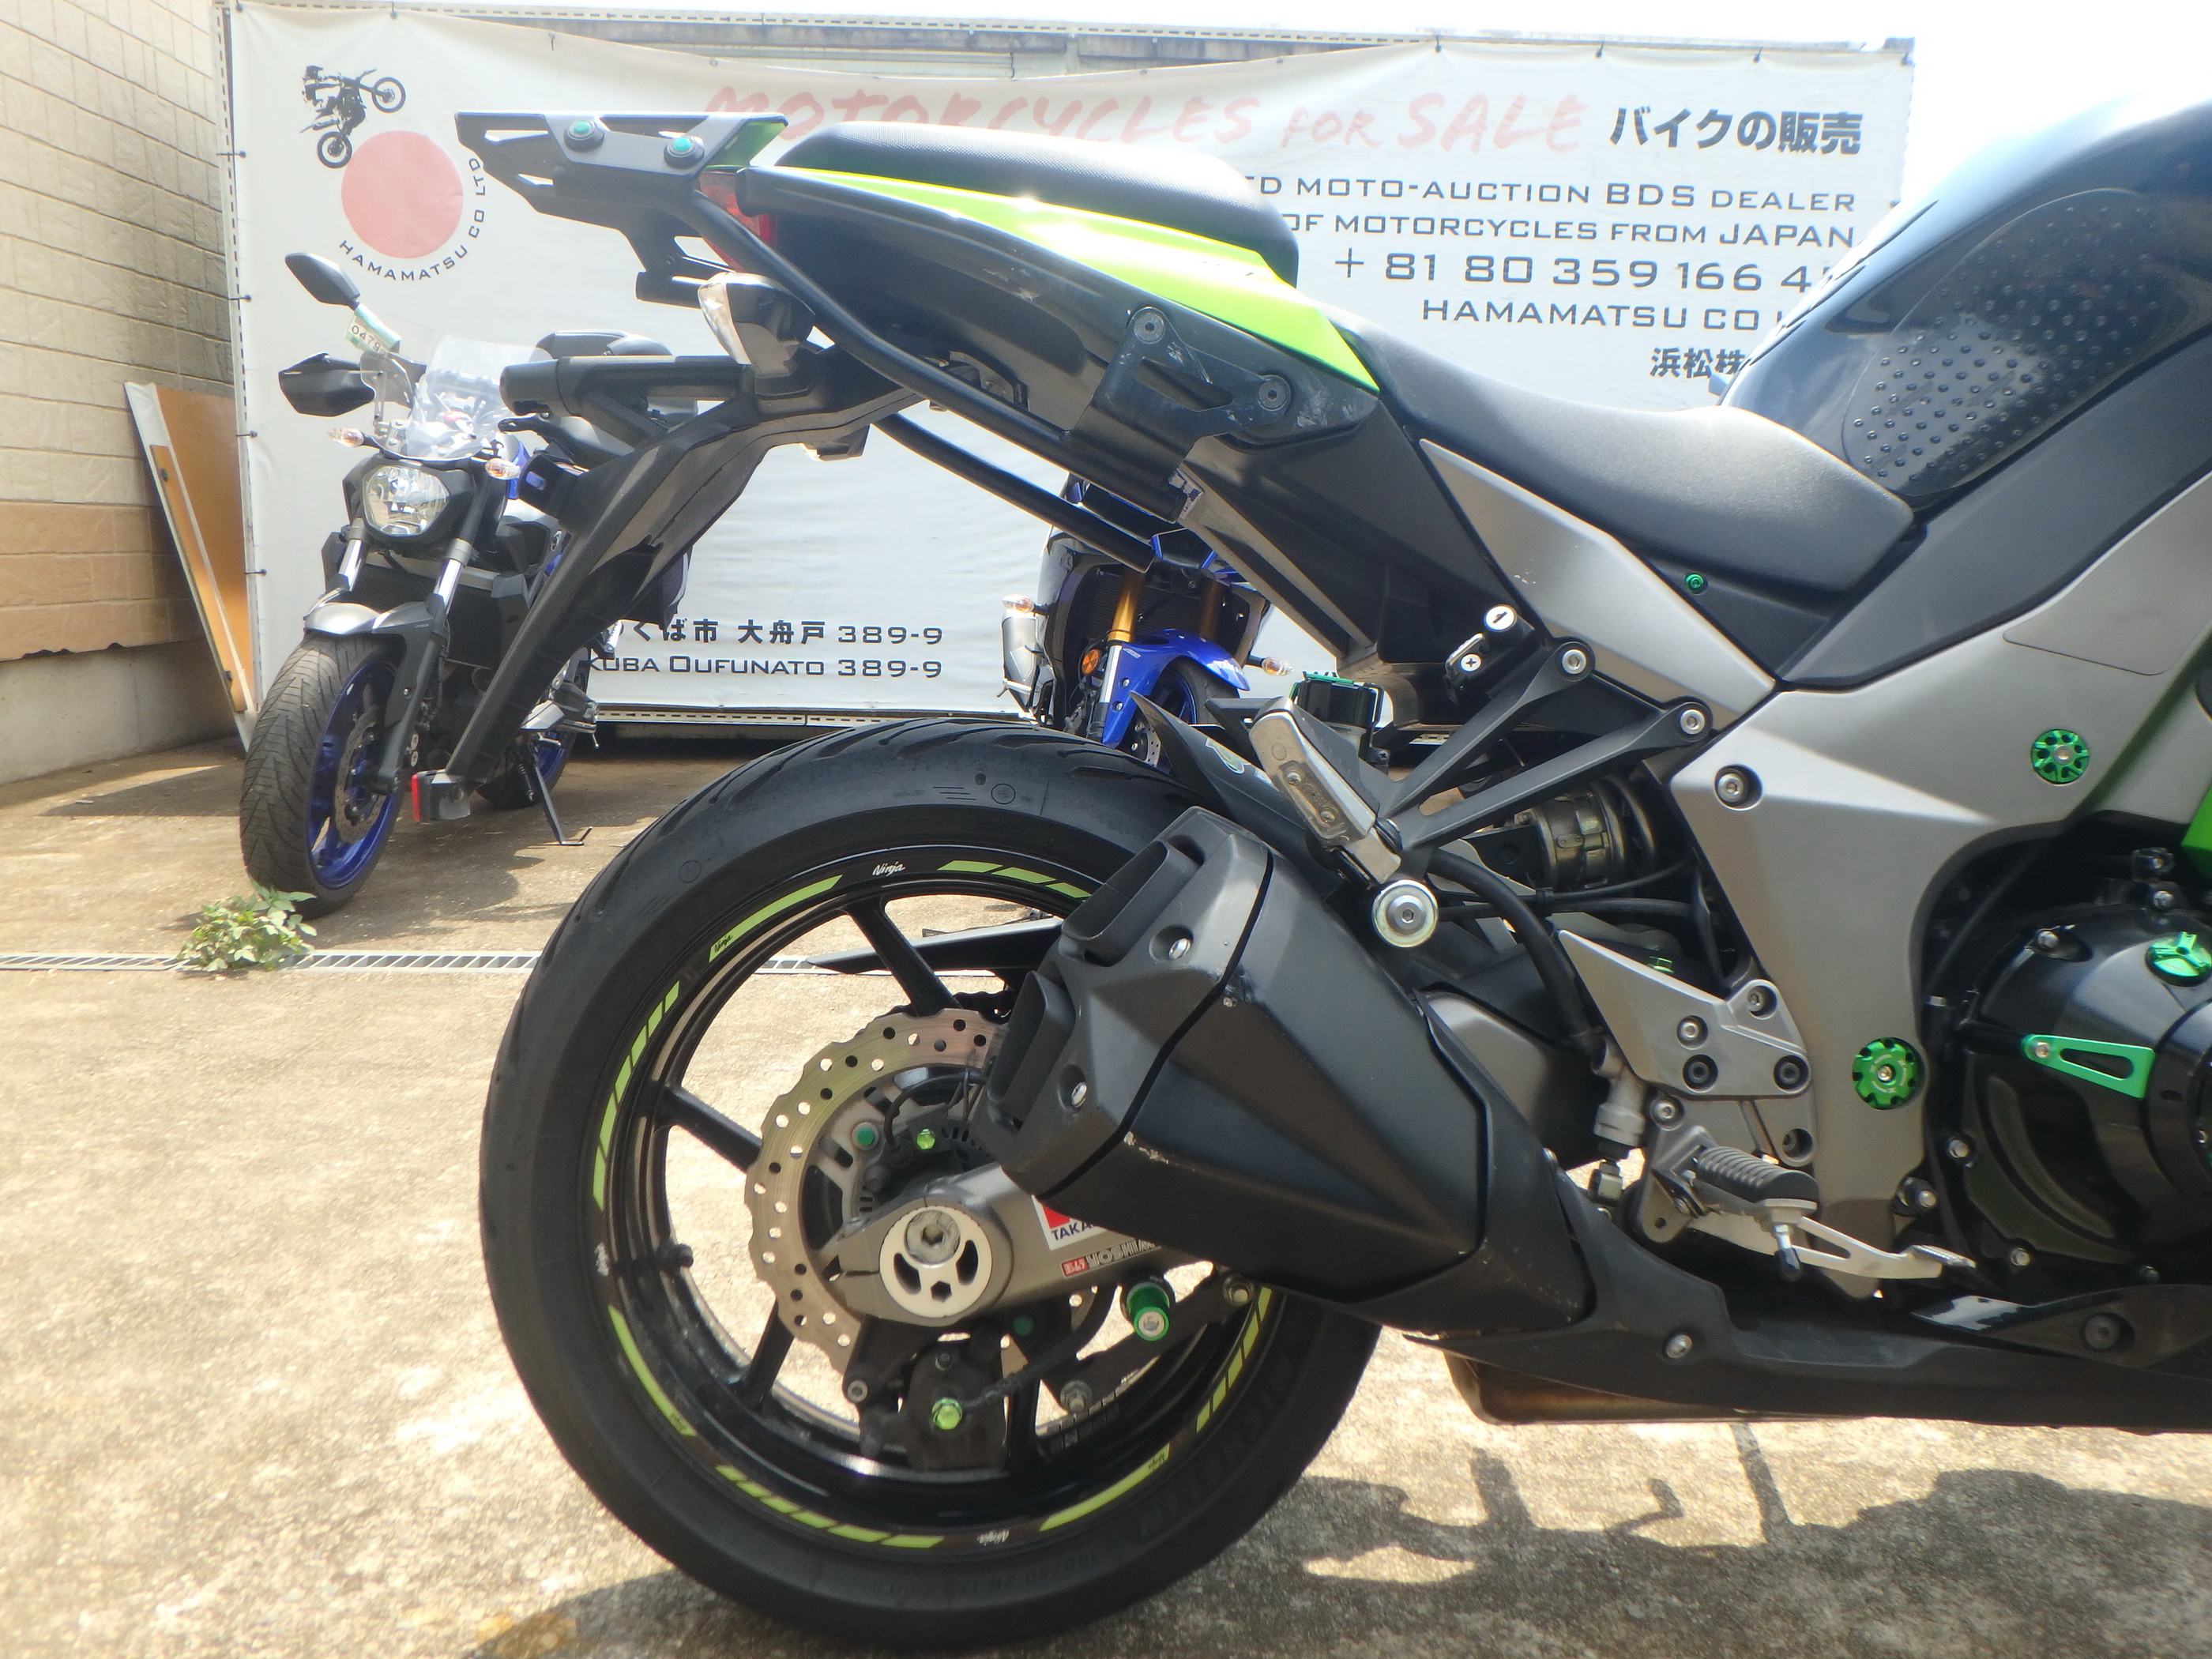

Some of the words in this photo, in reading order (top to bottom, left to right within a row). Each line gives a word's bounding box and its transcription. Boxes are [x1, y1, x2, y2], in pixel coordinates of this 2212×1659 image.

[1282, 106, 1383, 149] FOR
[1398, 92, 1589, 153] SALE
[1609, 106, 1864, 155] バイクの販売
[468, 158, 486, 196] LTD
[1297, 177, 1589, 204] MOTO-AUCTION
[1606, 182, 1695, 207] BDS
[1711, 190, 1855, 212] DEALER
[468, 209, 485, 238] CO
[1335, 214, 1597, 240] MOTORCYCLES
[1611, 224, 1706, 243] FROM
[1719, 224, 1855, 248] JAPAN
[340, 240, 468, 281] HAMAMATSU
[1385, 253, 1436, 281] 81
[1465, 254, 1533, 284] 80
[1781, 265, 1830, 293] 4
[1423, 299, 1687, 329] HAMAMATSU
[1702, 307, 1760, 331] CO
[738, 619, 826, 645] 大舟戸
[837, 626, 943, 645] 389-9
[669, 655, 825, 676] OUFUNATO
[837, 659, 942, 678] 389-9
[872, 861, 906, 877] Ninja
[713, 934, 733, 954] Ninja
